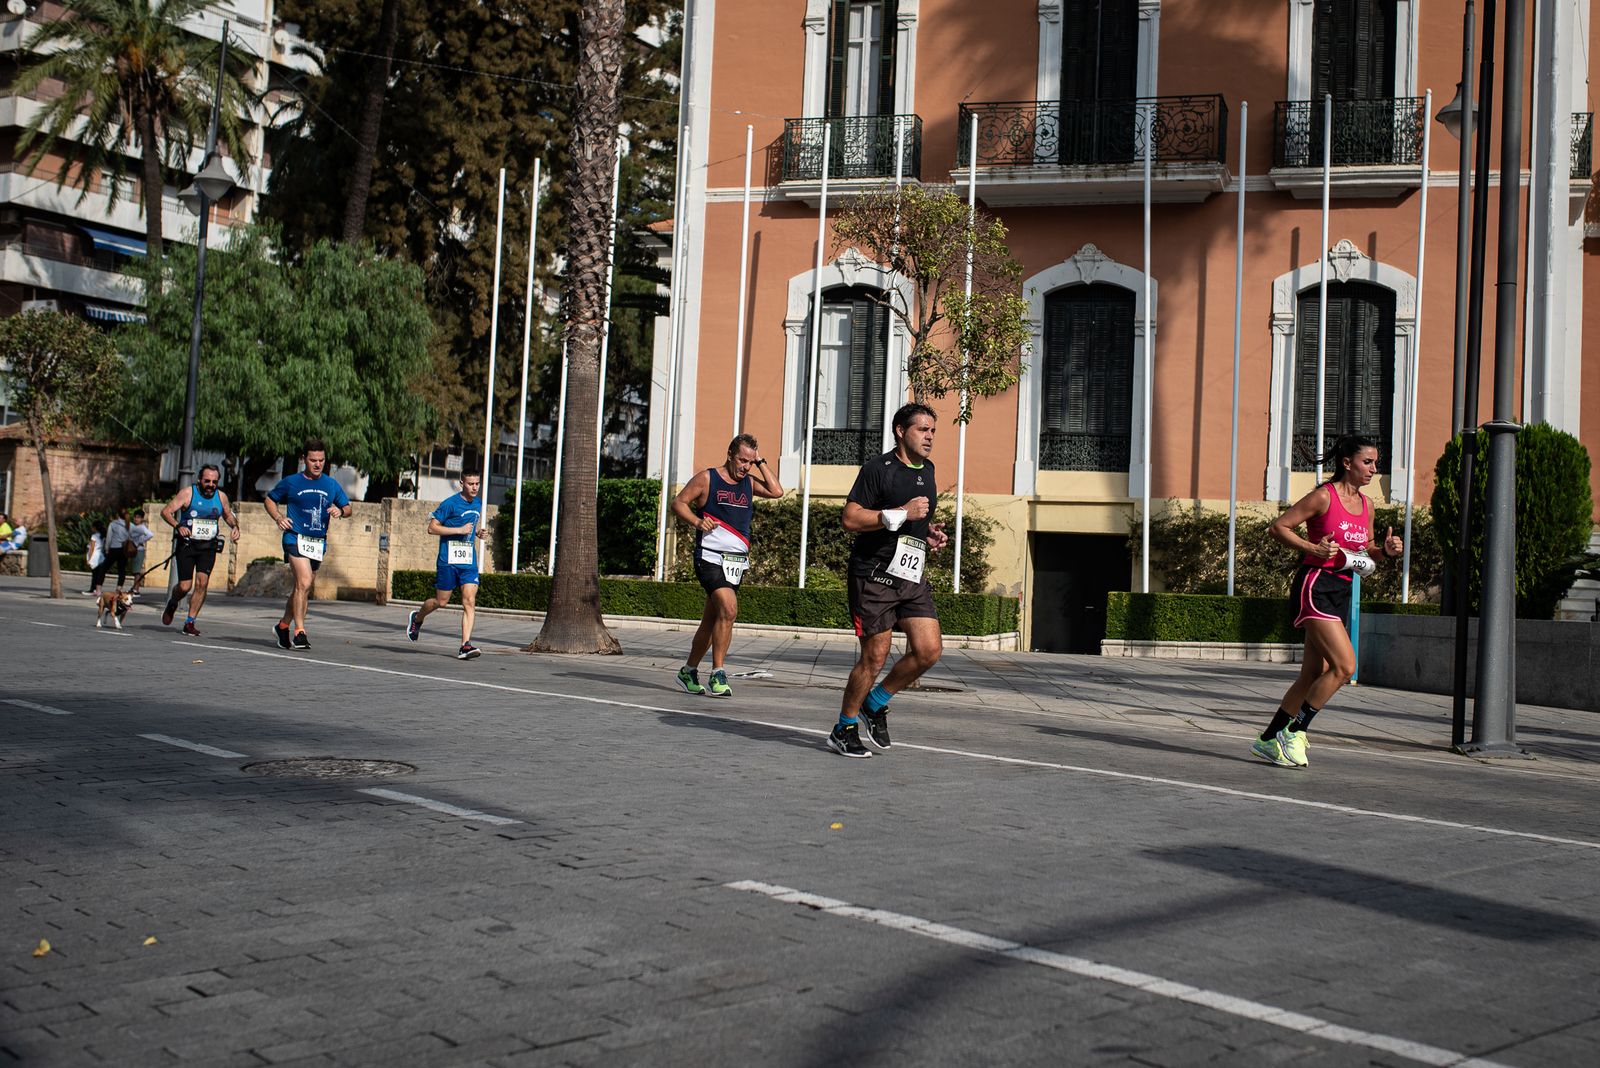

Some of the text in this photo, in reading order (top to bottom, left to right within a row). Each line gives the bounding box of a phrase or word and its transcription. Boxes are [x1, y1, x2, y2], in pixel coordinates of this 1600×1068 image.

[717, 490, 749, 505] FILA
[196, 527, 210, 536] 258
[302, 544, 315, 553] 129
[453, 550, 467, 558] 130
[900, 553, 919, 571] 612
[726, 566, 740, 577] 110
